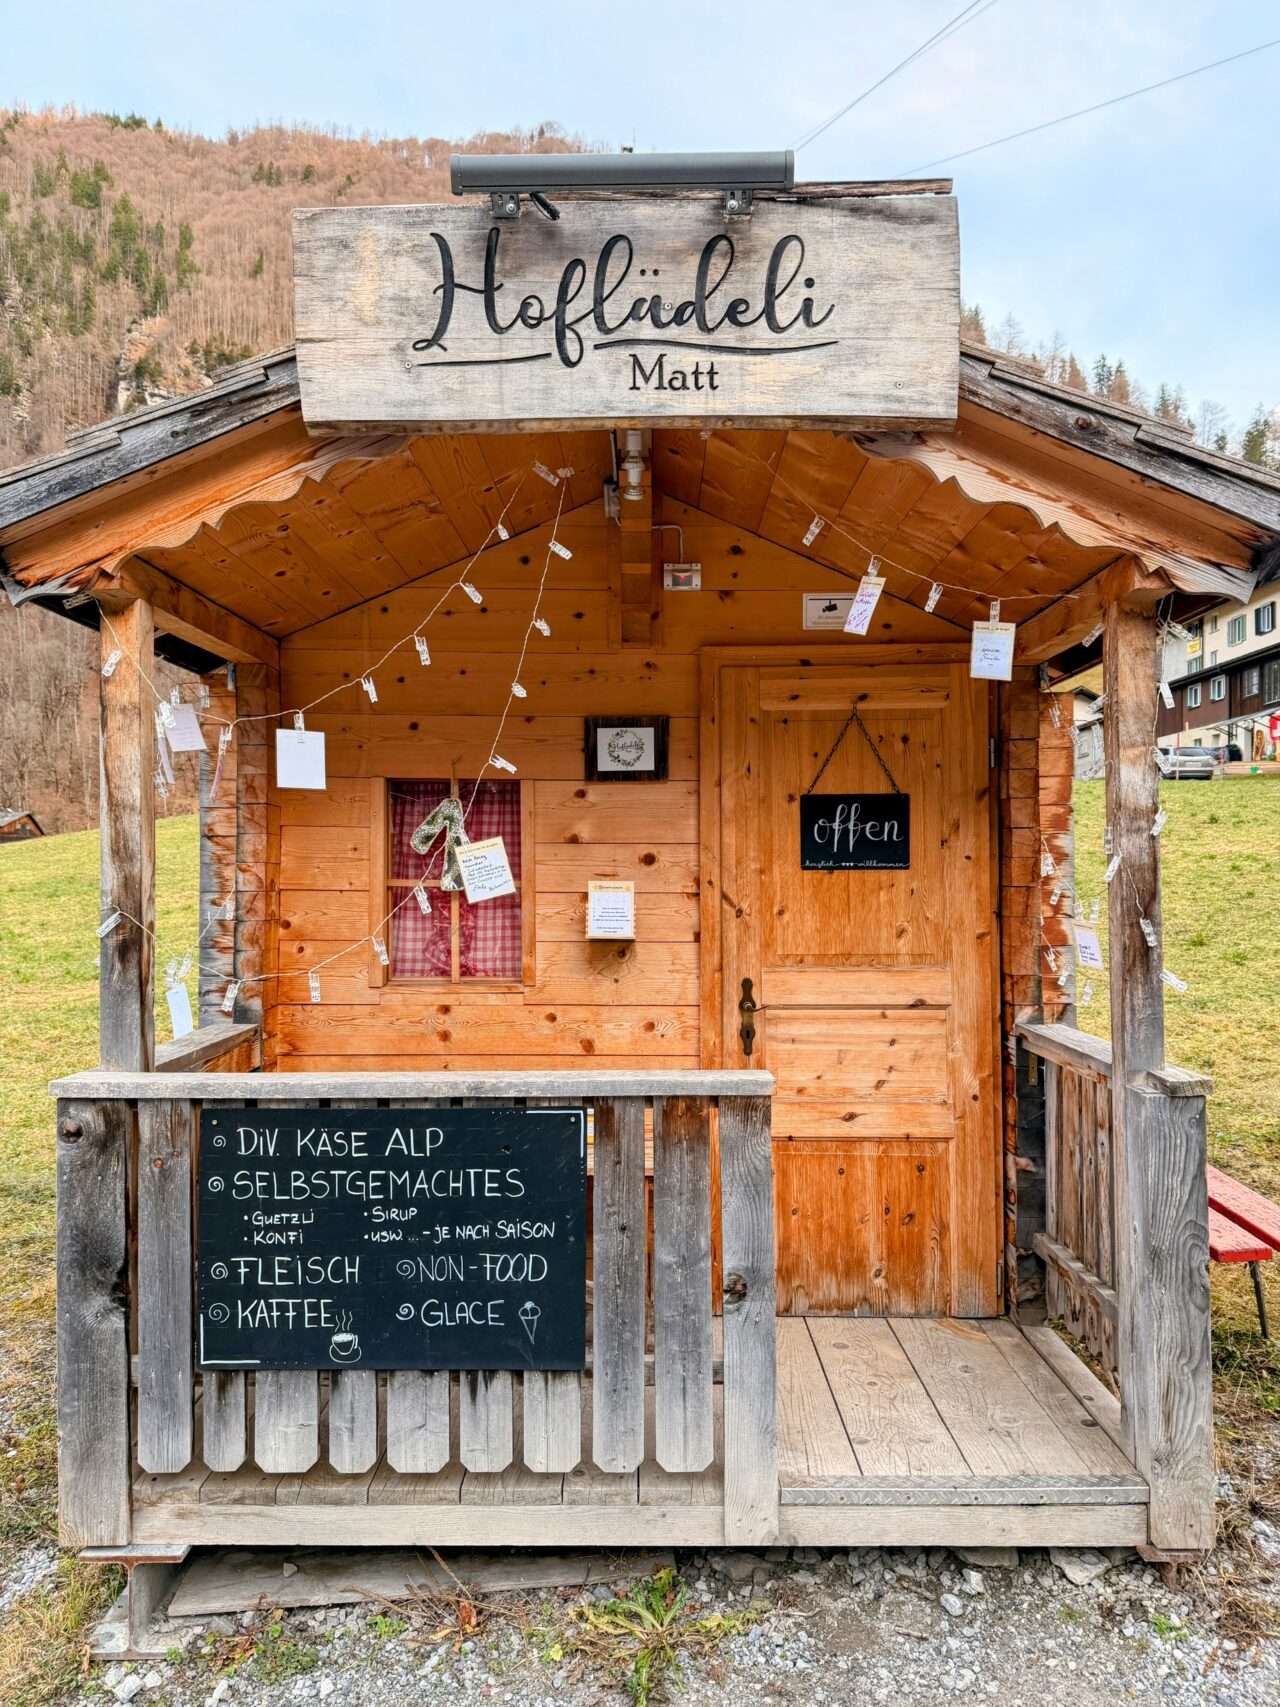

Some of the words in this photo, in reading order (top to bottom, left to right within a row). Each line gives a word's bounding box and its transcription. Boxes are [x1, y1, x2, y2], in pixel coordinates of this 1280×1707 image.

[413, 227, 835, 368] Hoflädeli
[629, 354, 720, 390] Matt
[814, 803, 904, 853] offen
[296, 1126, 369, 1157] KÄSE
[385, 1127, 445, 1157] ALP
[232, 1167, 526, 1201] SELBSTGEMACHTES
[371, 1206, 418, 1223] SIRUP
[456, 1223, 491, 1241] NACH
[237, 1299, 336, 1330] KAFFEE
[420, 1299, 506, 1327] GLACE
